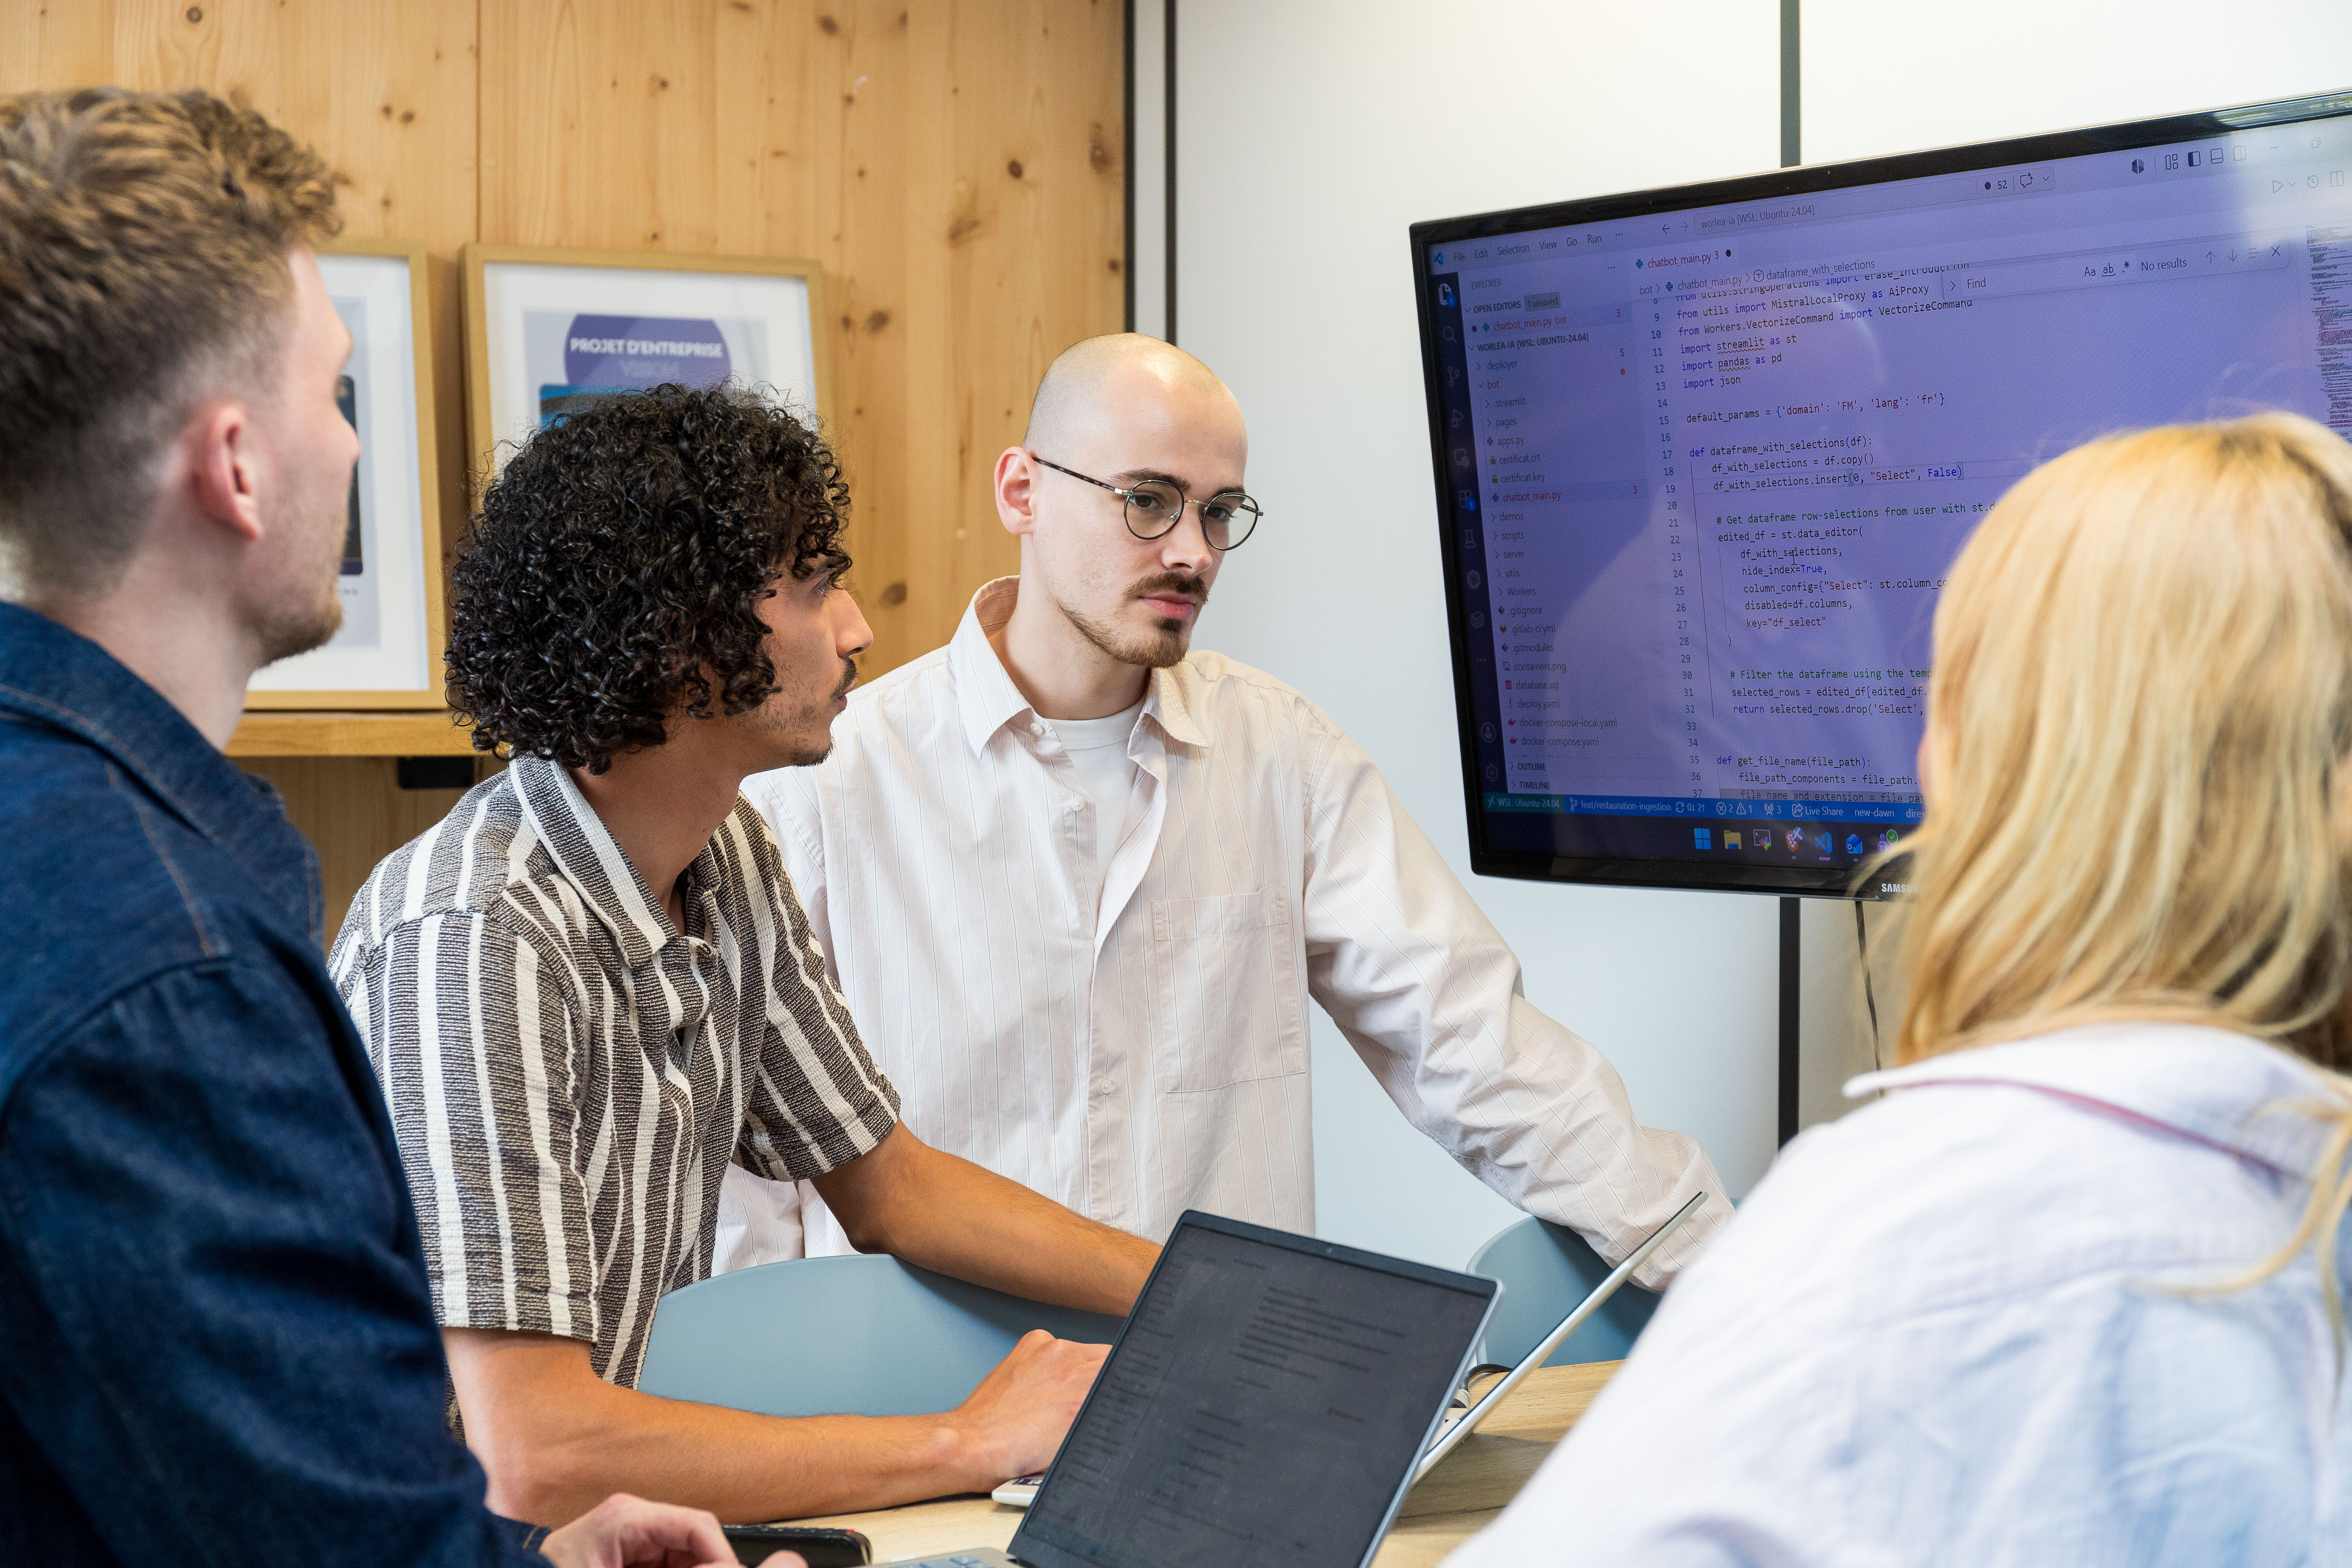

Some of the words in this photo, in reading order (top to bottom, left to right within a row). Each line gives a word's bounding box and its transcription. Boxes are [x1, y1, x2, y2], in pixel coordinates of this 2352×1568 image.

[1998, 180, 2007, 189] 52
[1701, 217, 1735, 228] worlea-ia
[1737, 213, 1758, 225] [WSL:
[1760, 205, 1815, 220] Ubuntu-24.04]
[1475, 249, 1488, 259] Edit
[1498, 243, 1530, 256] Selection
[1539, 240, 1557, 250] View
[1566, 237, 1577, 247] Go
[1587, 234, 1602, 243] Run
[1648, 253, 1711, 268] chatbot_main.py
[1715, 251, 1719, 259] 3
[2141, 261, 2155, 271] No
[2158, 258, 2187, 270] results
[2084, 266, 2096, 277] Aa
[1640, 285, 1653, 294] bot
[1678, 276, 1743, 291] chatbot_main.py
[1767, 260, 1875, 280] dataframe_with_selections
[1471, 278, 1502, 289] EXPLORER
[1967, 277, 1986, 289] Find
[1533, 297, 1558, 306] unsaved
[1677, 309, 1698, 319] from
[1703, 306, 1729, 317] utils
[1735, 302, 1766, 314] import
[1772, 291, 1866, 309] MistralLocalProxy
[1889, 283, 1929, 297] AiProxy
[1474, 303, 1491, 314] OPEN
[1494, 300, 1521, 311] EDITORS
[1617, 309, 1621, 317] 3
[1494, 318, 1552, 331] chatbot_main.py
[1555, 315, 1567, 325] bot
[1679, 326, 1700, 337] from
[1704, 312, 1834, 334] Workers.VectorizeCommand
[1840, 308, 1873, 320] import
[1879, 300, 1972, 316] VectorizeCommand
[1651, 331, 1661, 339] 10
[1478, 341, 1516, 352] WORLEA-IA
[1517, 338, 1535, 349] [WSL:
[1537, 333, 1589, 346] UBUNTU-24.04]
[1681, 343, 1711, 354] import
[1717, 337, 1764, 351] streamlit
[1787, 335, 1797, 343] st
[1682, 360, 1713, 371] import
[1718, 357, 1749, 369] pandas
[1772, 353, 1782, 364] pd
[1655, 365, 1664, 373] 12
[1487, 380, 1500, 389] bot
[1656, 382, 1666, 390] 13
[1684, 377, 1714, 389] import
[1720, 375, 1741, 387] json
[1687, 409, 1760, 423] default_params
[1776, 403, 1830, 418] {'domain':
[1837, 400, 1863, 411] 'FM',
[1871, 397, 1908, 409] 'lang':
[1496, 417, 1517, 428] pages
[1660, 416, 1669, 425] 15
[1498, 435, 1525, 447] apps.py
[1690, 447, 1705, 457] def
[1710, 435, 1871, 456] dataframe_with_selections(df):
[1499, 453, 1540, 464] certificat.crt
[1663, 450, 1672, 459] 17
[1712, 458, 1807, 474] df_with_selections
[1825, 453, 1873, 466] df.copy()
[1664, 467, 1674, 476] 18
[1928, 466, 1962, 479] False)
[1501, 472, 1545, 484] certificat.key
[1666, 484, 1675, 493] 19
[1503, 491, 1561, 503] chatbot_main.py
[1500, 512, 1524, 521] demos
[1727, 516, 1743, 525] Get
[1748, 513, 1796, 524] dataframe
[1802, 508, 1879, 521] row-selections
[1885, 507, 1908, 516] from
[1914, 506, 1936, 514] user
[1942, 504, 1965, 513] with
[1669, 519, 1678, 527] 21
[1502, 531, 1524, 542] scripts
[1718, 531, 1765, 543] edited_df
[1782, 526, 1864, 539] st.data_editor(
[1671, 536, 1680, 544] 22
[1672, 553, 1682, 561] 23
[1741, 547, 1842, 561] df_with_selections,
[1506, 569, 1520, 577] utils
[1674, 570, 1683, 578] 24
[1508, 587, 1536, 596] Workers
[1675, 586, 1684, 595] 25
[1677, 603, 1686, 612] 26
[1745, 598, 1853, 610] disabled=df.columns,
[1678, 621, 1687, 629] 27
[1747, 617, 1826, 629] key="df_select"
[1514, 662, 1566, 672] containers.png
[1683, 671, 1692, 680] 30
[1741, 670, 1772, 679] Filter
[1778, 670, 1793, 679] the
[1799, 669, 1848, 678] dataframe
[1854, 669, 1881, 680] using
[1887, 669, 1904, 678] the
[1516, 680, 1559, 691] database.sql
[1684, 688, 1694, 697] 31
[1732, 688, 1800, 698] selected_rows
[1518, 699, 1560, 710] deploy.yaml
[1686, 705, 1695, 713] 32
[1734, 705, 1764, 714] return
[1519, 718, 1617, 729] docker-compose-local.yaml
[1521, 737, 1599, 747] docker-compose.yaml
[1690, 756, 1700, 764] 35
[1717, 756, 1732, 765] def
[1738, 756, 1871, 768] get_file_name(file_path):
[1518, 762, 1546, 771] OUTLINE
[1691, 772, 1701, 781] 36
[1739, 772, 1845, 784] file_path_components
[1519, 781, 1550, 789] TIMELINE
[1498, 798, 1514, 807] WSL:
[1516, 798, 1560, 808] Ubuntu-24.04
[1581, 800, 1671, 813] feat/restauration-ingestion
[1729, 804, 1733, 813] 2
[1777, 806, 1781, 815] 3
[1805, 806, 1821, 816] Live
[1822, 807, 1843, 816] Share
[1854, 809, 1895, 818] new-dawn
[1882, 883, 1920, 893] SAMSU
